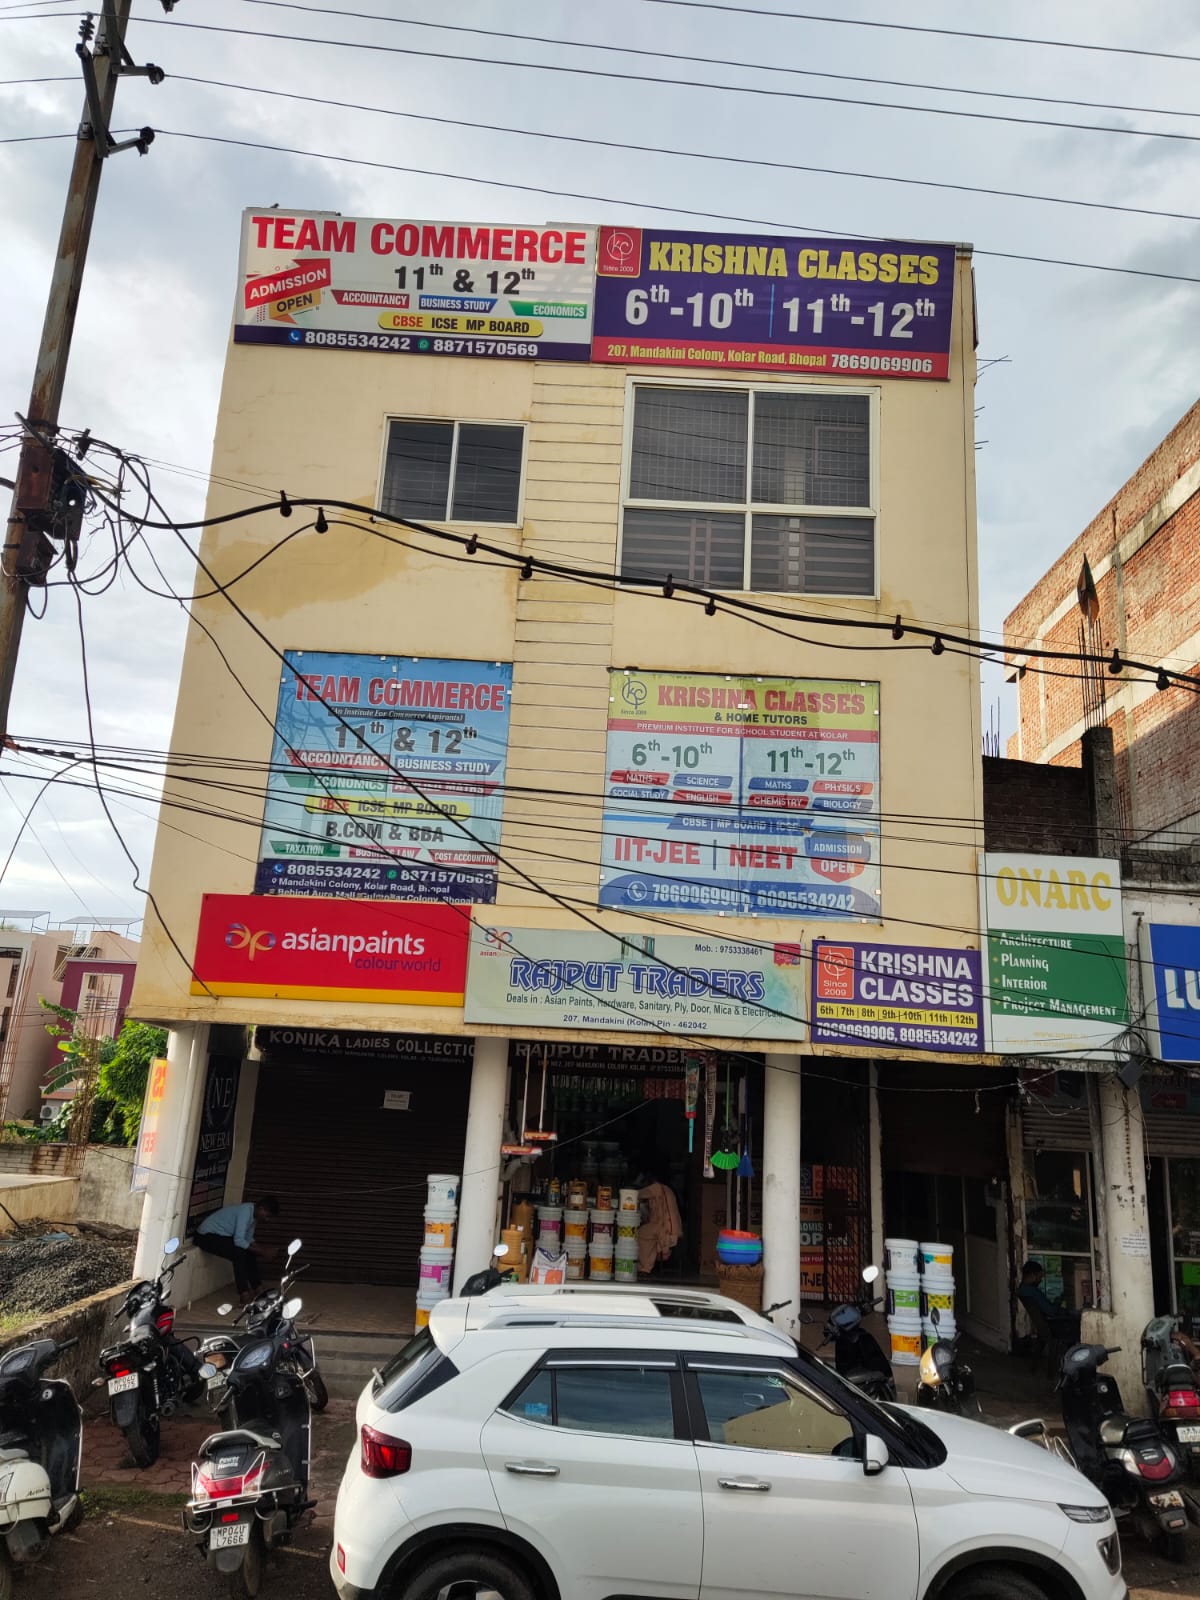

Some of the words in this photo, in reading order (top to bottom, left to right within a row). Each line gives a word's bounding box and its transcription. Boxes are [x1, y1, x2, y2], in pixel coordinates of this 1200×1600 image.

[251, 216, 357, 253] TEAM
[370, 222, 587, 264] COMMERCE
[648, 241, 788, 278] KRISHNA
[798, 249, 940, 285] CLASSES
[249, 267, 327, 301] ADMISSION
[395, 264, 443, 290] 11th
[453, 269, 474, 293] &
[486, 268, 535, 295] 12th
[276, 293, 313, 313] OPEN
[342, 292, 408, 307] ACCOUNTANCY
[420, 297, 462, 310] BUSINESS
[463, 299, 491, 312] STUDY
[532, 304, 585, 318] ECONOMICS
[392, 315, 423, 328] CBSE
[431, 317, 458, 330] ICSE
[465, 319, 487, 332] MP
[489, 320, 530, 334] BOARD
[305, 331, 410, 350] 8085534242
[433, 338, 538, 357] 8871570569
[607, 343, 629, 358] 207,
[630, 345, 686, 359] Mandakini
[687, 347, 726, 363] Colony,
[727, 349, 754, 363] Kolar
[757, 350, 788, 365] Road,
[789, 352, 827, 368] Bhopal
[831, 353, 933, 373] 7869069906
[295, 674, 361, 704] TEAM
[368, 677, 505, 712] COMMERCE
[658, 685, 757, 711] KRISHNA
[764, 689, 865, 715] CLASSES
[714, 712, 723, 721] &
[726, 712, 759, 723] HOME
[763, 715, 808, 725] TUTORS
[335, 720, 385, 750] 11th
[393, 727, 415, 752] &
[428, 726, 477, 755] 12th
[637, 723, 673, 732] PREMIUM
[675, 724, 715, 734] INSTITUTE
[716, 726, 733, 735] FOR
[735, 727, 768, 737] SCHOOL
[769, 729, 807, 738] STUDENT
[808, 730, 819, 739] AT
[820, 731, 848, 740] KOLAR
[300, 751, 387, 767] ACCOUNTANCY
[397, 758, 452, 771] BUSINESS
[455, 761, 491, 773] STUDY
[686, 776, 719, 786] SCIENCE
[764, 779, 792, 791] MATHS
[824, 782, 862, 794] PHYSICS
[612, 788, 640, 798] SOCIAL
[642, 790, 666, 800] STUDY
[754, 796, 803, 808] CHEMISTRY
[823, 799, 862, 810] BIOLOGY
[682, 817, 708, 827] CBSE
[326, 820, 382, 840] B.COM
[388, 824, 403, 841] &
[408, 826, 444, 843] BBA
[285, 843, 324, 855] TAXATION
[434, 852, 451, 861] COST
[454, 853, 496, 864] ACCOUNTING
[614, 837, 701, 865] IIT-JEE
[729, 844, 798, 871] NEET
[814, 843, 863, 855] ADMISSION
[287, 864, 381, 879] 8085534242
[820, 860, 855, 874] OPEN
[279, 877, 327, 888] Mandakini
[328, 880, 362, 892] Colony,
[364, 882, 389, 891] Kolar
[996, 866, 1112, 912] ONARC
[282, 927, 425, 963] asianpaints
[860, 951, 972, 980] KRISHNA
[510, 957, 624, 994] RAJPUT
[628, 963, 766, 1002] TRADERS
[824, 980, 847, 988] Since
[825, 988, 847, 997] 2009
[860, 977, 974, 1007] CLASSES
[506, 993, 529, 1004] Deals
[530, 994, 538, 1003] in
[544, 995, 567, 1006] Asian
[568, 996, 593, 1008] Paints,
[638, 1000, 672, 1014] Sanitary,
[674, 1002, 689, 1014] Ply,
[690, 1003, 712, 1015] Door,
[713, 1004, 732, 1015] Mica
[733, 1006, 741, 1016] &
[582, 1016, 624, 1026] Mandakini
[657, 1019, 670, 1028] Pin
[678, 1021, 707, 1030] 462042
[820, 1005, 834, 1015] 6th
[841, 1007, 854, 1017] 7th
[861, 1008, 875, 1018] 8th
[929, 1013, 947, 1023] 11th
[955, 1015, 974, 1025] 12th
[269, 1030, 340, 1047] KONIKA
[345, 1037, 390, 1049] LADIES
[900, 1029, 978, 1047] 8085534242
[216, 1533, 244, 1548] L7666
[217, 1525, 247, 1538] MP04U
